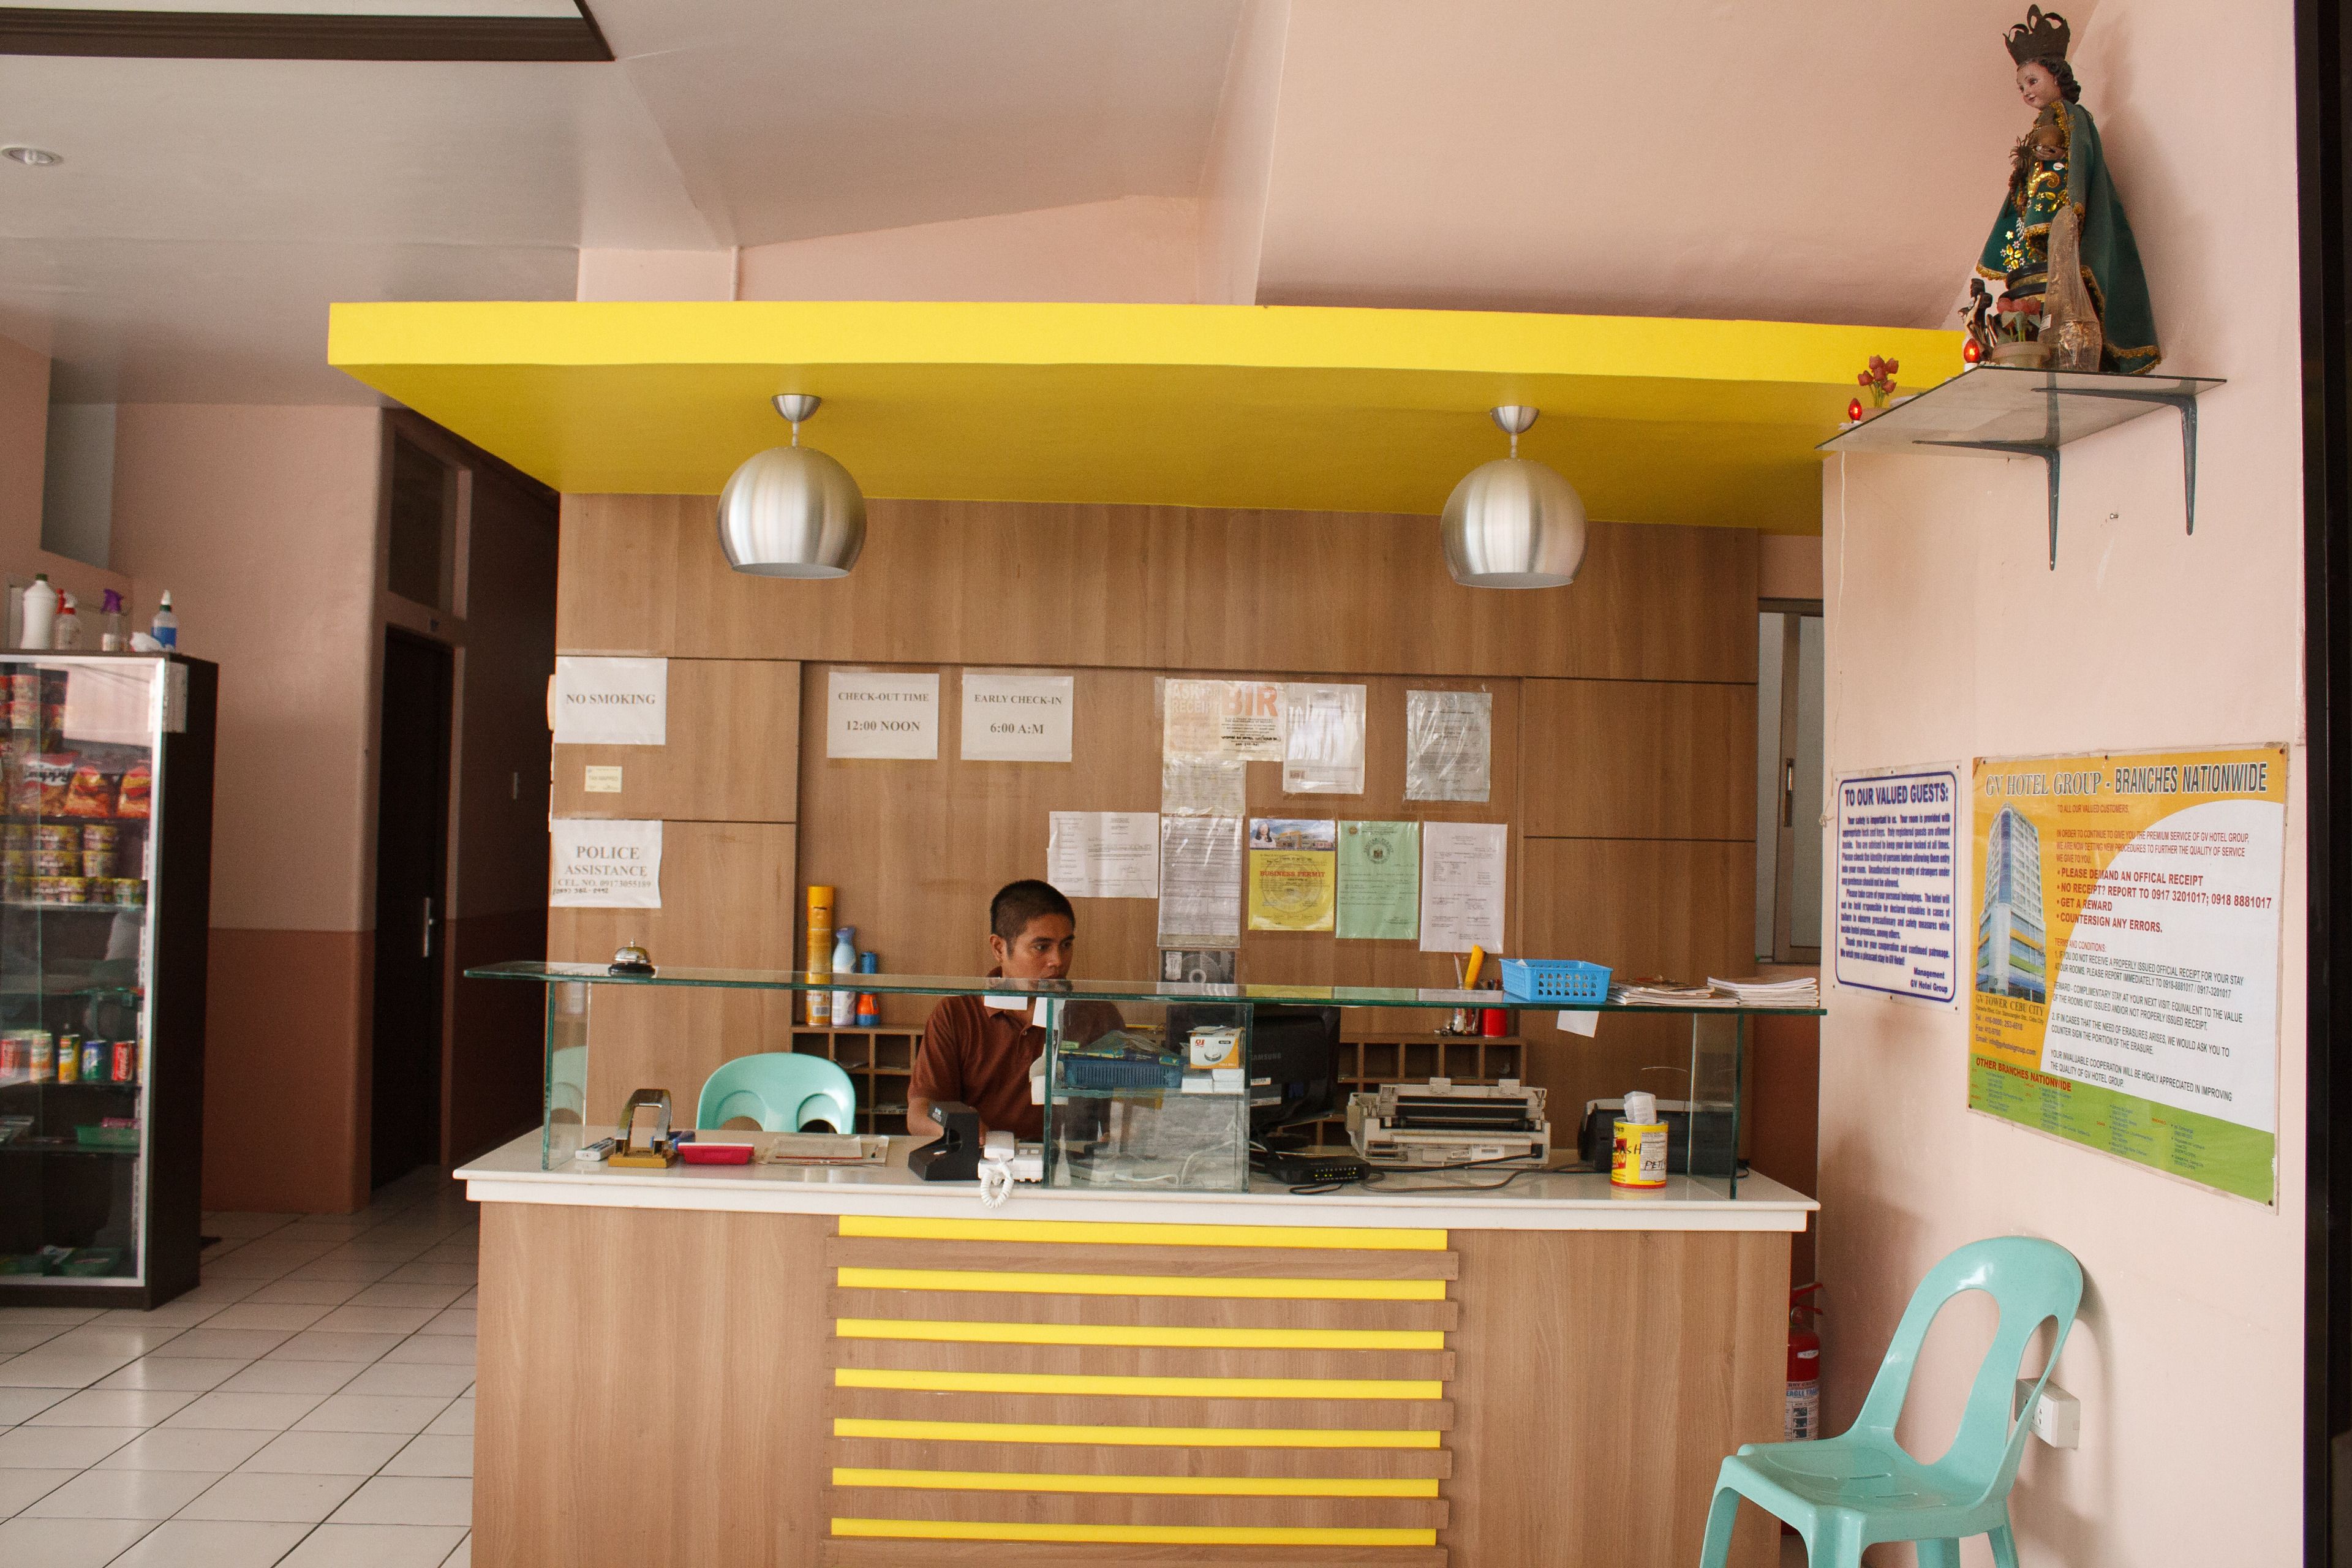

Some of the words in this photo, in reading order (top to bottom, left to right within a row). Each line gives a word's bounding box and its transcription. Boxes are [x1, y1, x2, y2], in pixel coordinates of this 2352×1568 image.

[566, 693, 586, 704] NO
[589, 693, 655, 705] SMOKING
[839, 692, 899, 701] CHECK-OUT
[902, 693, 929, 702] TIME
[974, 694, 1008, 703] EARLY
[1011, 695, 1063, 704] CHECK-IN
[1222, 685, 1278, 717] BIR
[846, 720, 876, 731] 12:00
[881, 721, 921, 731] NOON
[990, 723, 1014, 733] 6:00
[1986, 775, 2002, 796] GV
[2007, 774, 2048, 795] HOTEL
[2053, 772, 2101, 795] GROUP
[2115, 766, 2177, 794] BRANCHES
[2182, 763, 2267, 793] NATIONWIDE
[1845, 789, 1855, 807] TO
[1857, 788, 1874, 806] OUR
[1875, 785, 1907, 805] VALUED
[1910, 783, 1948, 804] GUESTS:
[2058, 804, 2063, 813] TO
[2072, 804, 2082, 813] OUR
[2083, 804, 2099, 813] VALUED
[2084, 829, 2106, 839] CONTINUE
[2136, 831, 2146, 840] THE
[2146, 831, 2169, 840] PREMIUM
[2170, 831, 2192, 841] SERVICE
[2193, 832, 2199, 842] OF
[2201, 832, 2208, 842] GV
[2209, 832, 2227, 842] HOTEL
[576, 846, 641, 859] POLICE
[2147, 845, 2154, 853] TO
[2155, 845, 2177, 854] FURTHER
[2179, 845, 2188, 854] THE
[2190, 846, 2212, 856] QUALITY
[2214, 846, 2220, 856] OF
[2222, 846, 2245, 857] SERVICE
[564, 864, 647, 876] ASSISTANCE
[2062, 867, 2087, 879] PLEASE
[2090, 869, 2118, 881] DEMAND
[2121, 871, 2131, 881] AN
[2134, 872, 2166, 884] OFFICAL
[2169, 873, 2203, 886] RECEIPT
[2061, 882, 2071, 892] NO
[2073, 883, 2105, 895] RECEIPT?
[2108, 886, 2136, 898] REPORT
[2139, 888, 2149, 899] TO
[2152, 889, 2169, 900] 0917
[2172, 890, 2209, 907] 3201017;
[2212, 893, 2231, 905] 0918
[2234, 895, 2272, 909] 8881017
[2061, 897, 2075, 908] GET
[2076, 899, 2081, 908] A
[2082, 899, 2112, 911] REWARD
[2060, 913, 2110, 927] COUNTERSIGN
[2113, 918, 2127, 929] ANY
[2130, 919, 2162, 932] ERRORS.
[2055, 938, 2068, 948] TERMS
[2078, 941, 2106, 952] CONDITIONS:
[1913, 967, 1945, 979] Management
[2079, 953, 2088, 963] NOT
[2089, 954, 2108, 966] RECEIVE
[2109, 957, 2113, 967] A
[2113, 958, 2136, 970] PROPERLY
[2138, 962, 2155, 973] ISSUED
[2157, 964, 2178, 976] OFFICIAL
[2179, 967, 2199, 979] RECEIPT
[2201, 970, 2212, 981] FOR
[2214, 972, 2228, 984] YOUR
[2230, 974, 2244, 986] STAY
[2087, 968, 2104, 978] PLEASE
[2105, 970, 2122, 981] REPORT
[2123, 973, 2154, 986] IMMEDIATELY
[2156, 978, 2162, 987] TO
[1918, 981, 1932, 990] Hotel
[1932, 983, 1948, 994] Group
[1975, 993, 1983, 1003] GV
[1985, 996, 2007, 1009] TOWER
[2010, 1001, 2027, 1012] CEBU
[2029, 1005, 2045, 1017] CITY
[2068, 996, 2082, 1007] ROOMS
[2084, 999, 2092, 1009] NOT
[2094, 1001, 2111, 1012] ISSUED
[2129, 1007, 2139, 1018] NOT
[2140, 1009, 2165, 1023] PROPERLY
[2166, 1014, 2183, 1026] ISSUED
[2073, 985, 2110, 1000] COMPLIMENTARY
[2112, 991, 2121, 1001] STAY
[2123, 993, 2128, 1003] AT
[2130, 994, 2143, 1005] YOUR
[2144, 997, 2157, 1008] NEXT
[2171, 1001, 2203, 1016] EQUIVALENT
[2204, 1007, 2211, 1017] TO
[2213, 1008, 2222, 1019] THE
[2224, 1010, 2242, 1023] VALUE
[2051, 1024, 2071, 1036] COUNTER
[2072, 1028, 2082, 1039] SIGN
[2092, 1033, 2113, 1046] PORTION
[2120, 1039, 2129, 1049] THE
[2065, 1014, 2080, 1026] CASES
[2081, 1017, 2091, 1028] THAT
[2092, 1020, 2101, 1030] THE
[2102, 1022, 2114, 1033] NEED
[2116, 1025, 2122, 1035] OF
[2122, 1026, 2147, 1040] ERASURES
[2168, 1035, 2175, 1046] WE
[2176, 1037, 2196, 1050] WOULD
[2197, 1041, 2207, 1052] ASK
[2209, 1044, 2220, 1055] YOU
[2222, 1046, 2230, 1057] TO
[1976, 1057, 1996, 1071] OTHER
[1999, 1063, 2029, 1080] BRANCHES
[2030, 1072, 2071, 1091] NATIONWIDE
[2051, 1048, 2062, 1060] YOUR
[2063, 1051, 2089, 1066] INVALUABLE
[2090, 1058, 2122, 1074] COOPERATION
[2123, 1066, 2133, 1077] WILL
[2135, 1069, 2141, 1079] BE
[2141, 1070, 2158, 1084] HIGHLY
[2160, 1075, 2193, 1092] APPRECIATED
[2195, 1084, 2199, 1094] IN
[2201, 1085, 2232, 1101] IMPROVING
[2059, 1063, 2076, 1076] QUALITY
[2092, 1071, 2107, 1084] HOTEL
